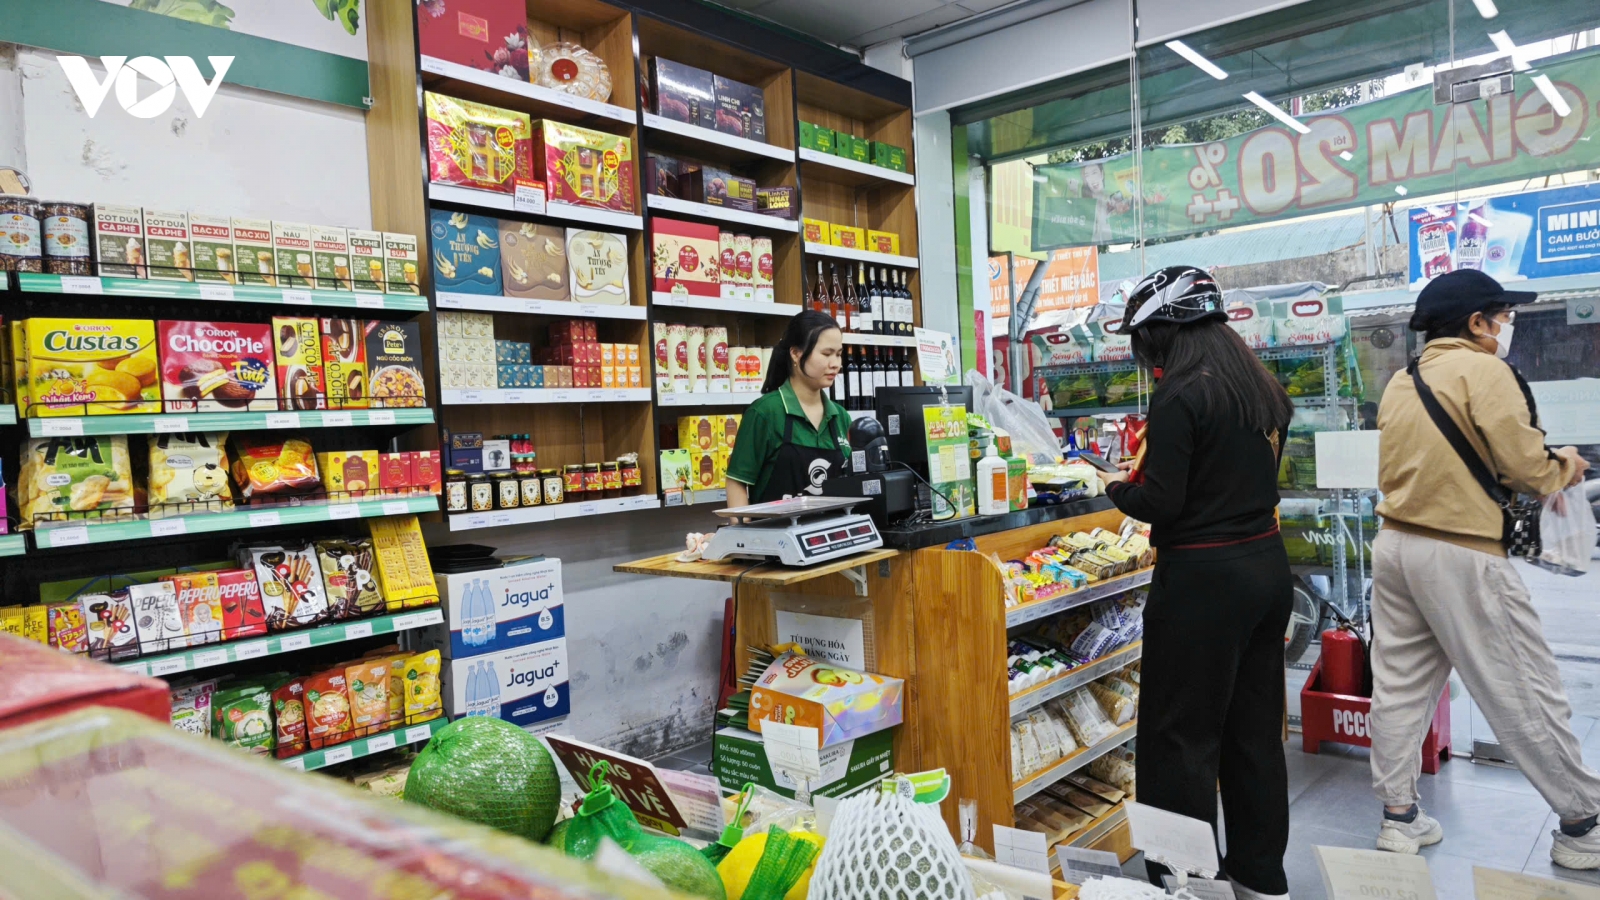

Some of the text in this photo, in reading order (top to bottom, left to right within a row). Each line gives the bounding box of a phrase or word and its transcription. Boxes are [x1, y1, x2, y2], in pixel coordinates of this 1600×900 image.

[1547, 209, 1600, 231] MIN
[1548, 234, 1573, 245] CAM
[206, 329, 237, 337] ORION
[378, 324, 408, 340] GRANOLA
[44, 331, 139, 352] Custas
[169, 334, 265, 353] ChocoPie
[947, 421, 960, 437] 20
[179, 586, 220, 604] PEPERO
[220, 581, 259, 599] PEPERO
[790, 634, 803, 644] TÚI
[828, 639, 845, 650] HÓA
[828, 652, 851, 662] NGÀY
[819, 750, 840, 762] SAKURA
[850, 762, 866, 773] SAKURA
[630, 785, 670, 818] VỀ
